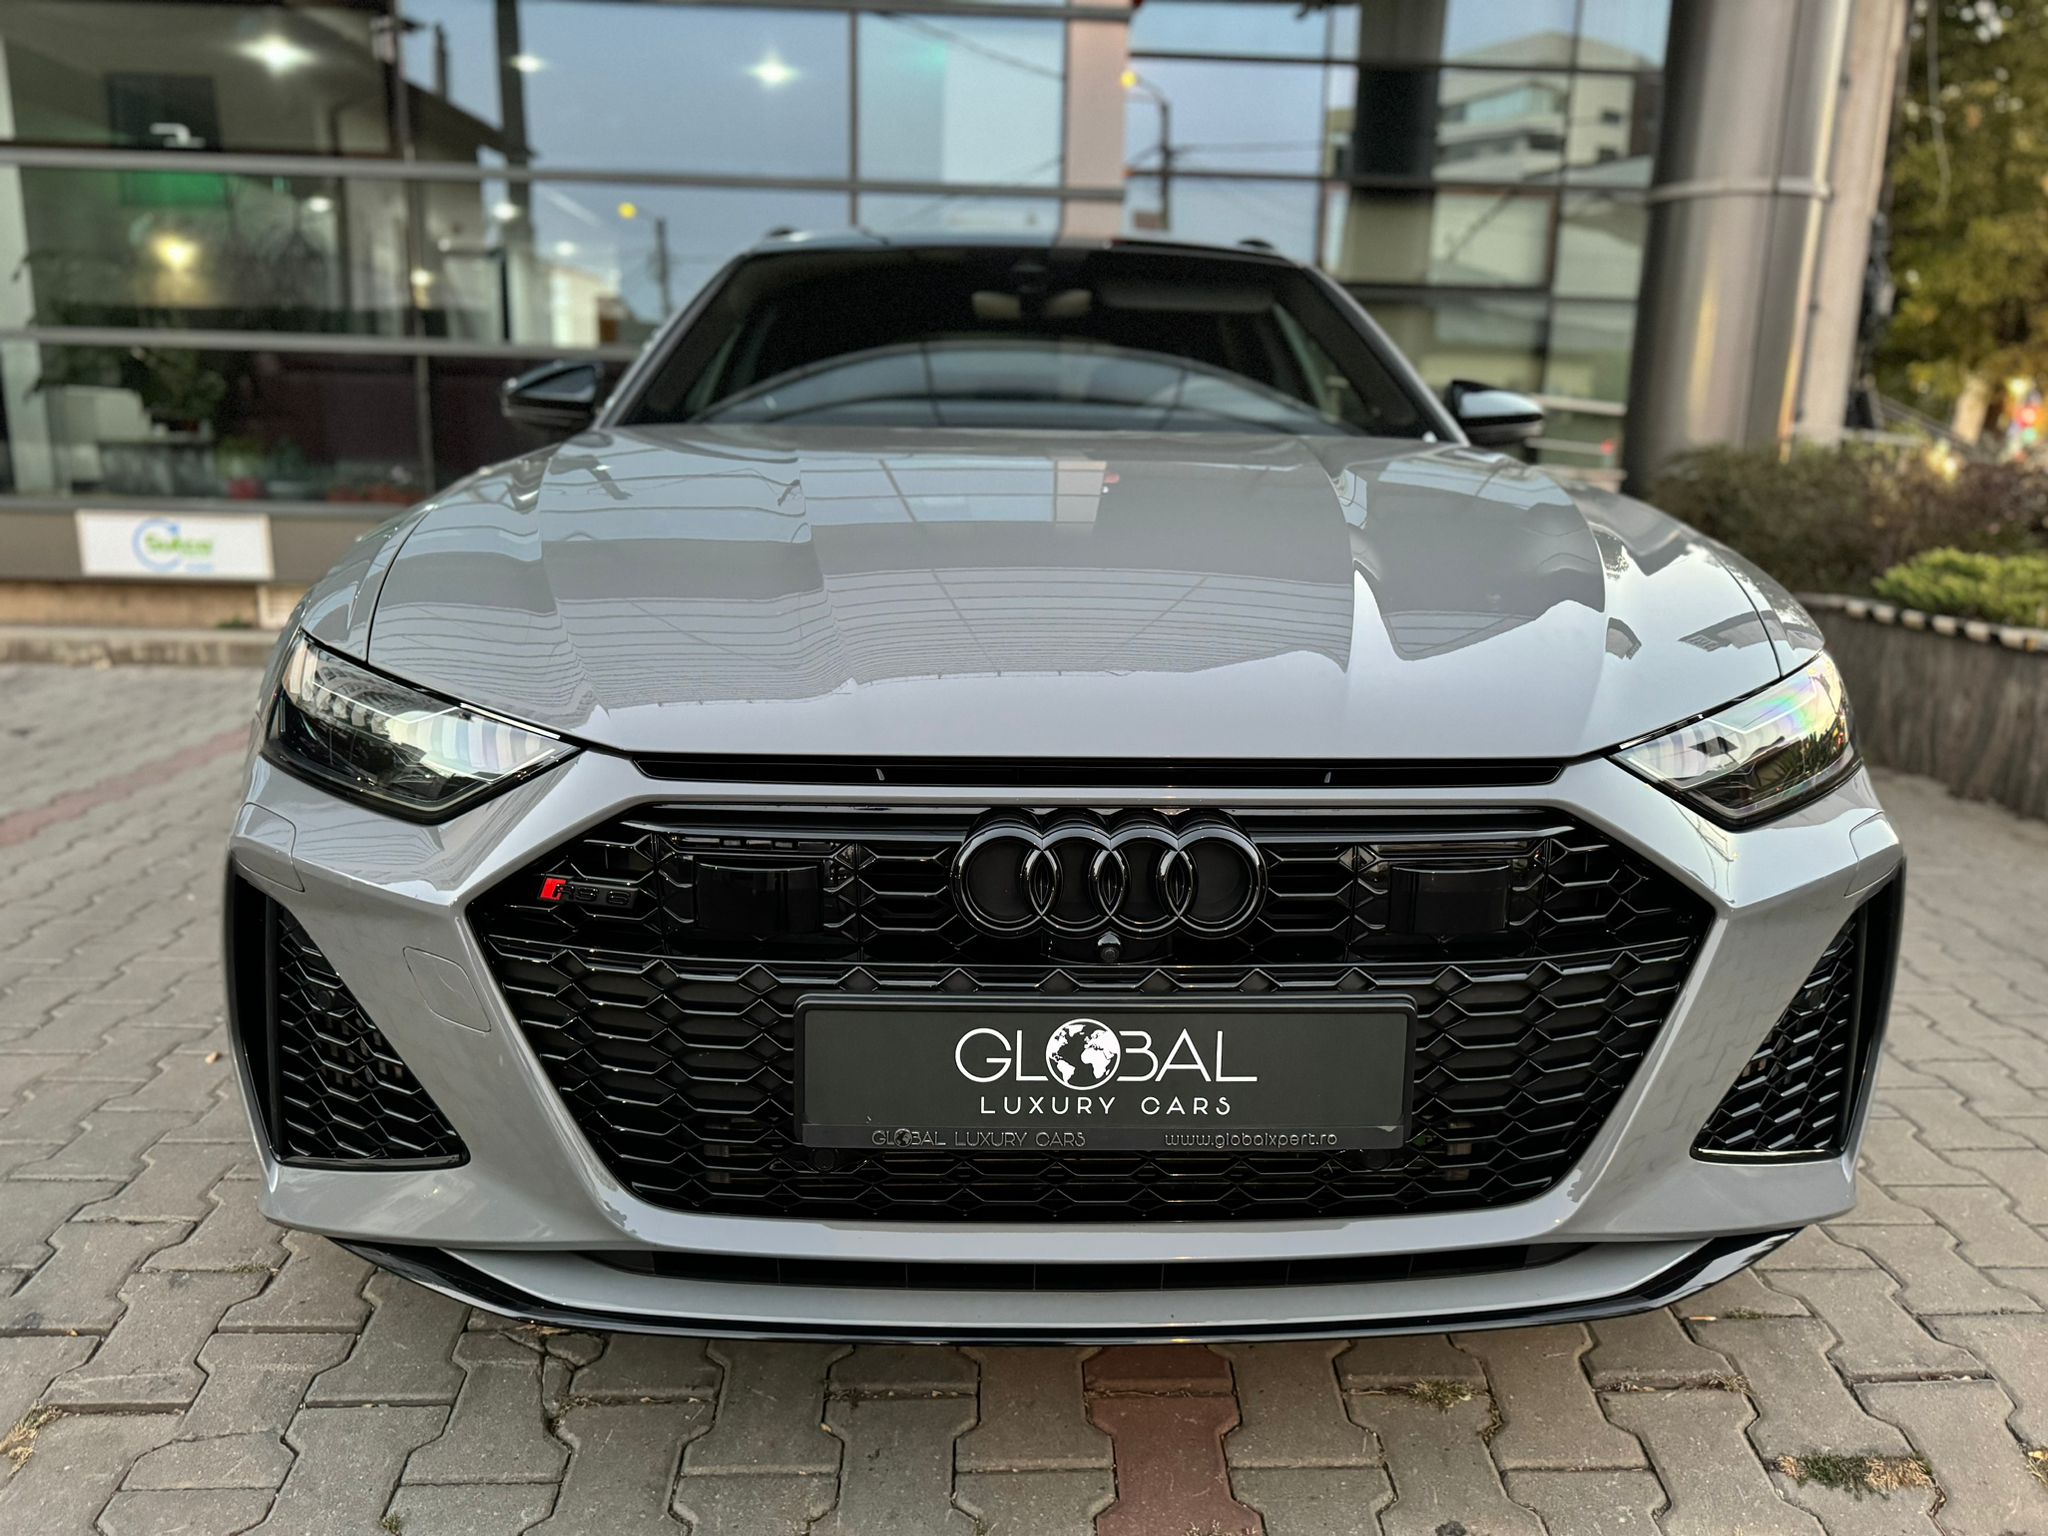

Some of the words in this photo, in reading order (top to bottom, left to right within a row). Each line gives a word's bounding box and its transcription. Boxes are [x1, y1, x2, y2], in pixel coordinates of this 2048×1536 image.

[955, 1018, 1258, 1090] GLOBAL
[980, 1096, 1118, 1115] LUXURY
[1140, 1096, 1231, 1116] CARS
[871, 1128, 947, 1148] GLOBAL
[954, 1131, 1028, 1147] LUXURY
[1035, 1131, 1086, 1147] CARS
[1165, 1132, 1338, 1149] www.globalxpert.ro
